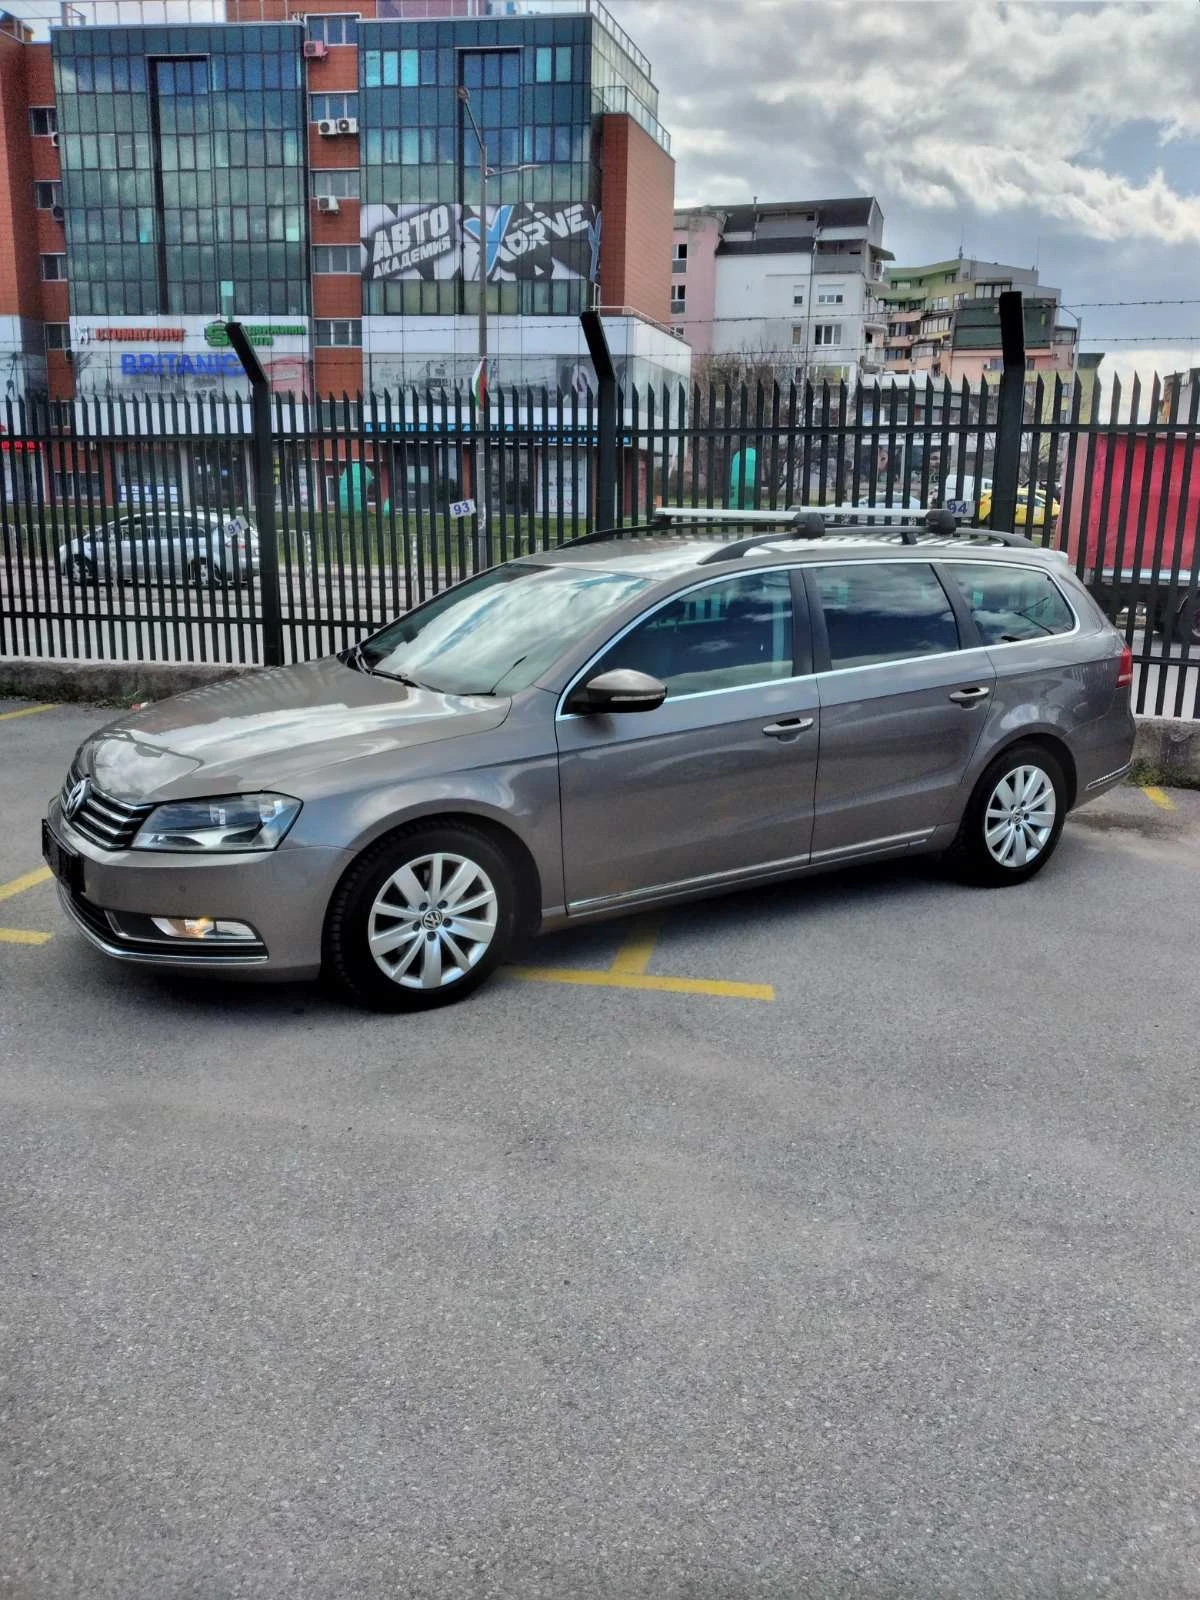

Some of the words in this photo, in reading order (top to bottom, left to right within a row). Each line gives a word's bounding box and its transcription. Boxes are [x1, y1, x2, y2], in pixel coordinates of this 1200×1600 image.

[373, 205, 449, 262] АВТО
[373, 235, 451, 279] АКАДЕМИЯ
[121, 353, 247, 375] BRITANIC
[453, 502, 470, 515] 93
[947, 499, 968, 514] 94
